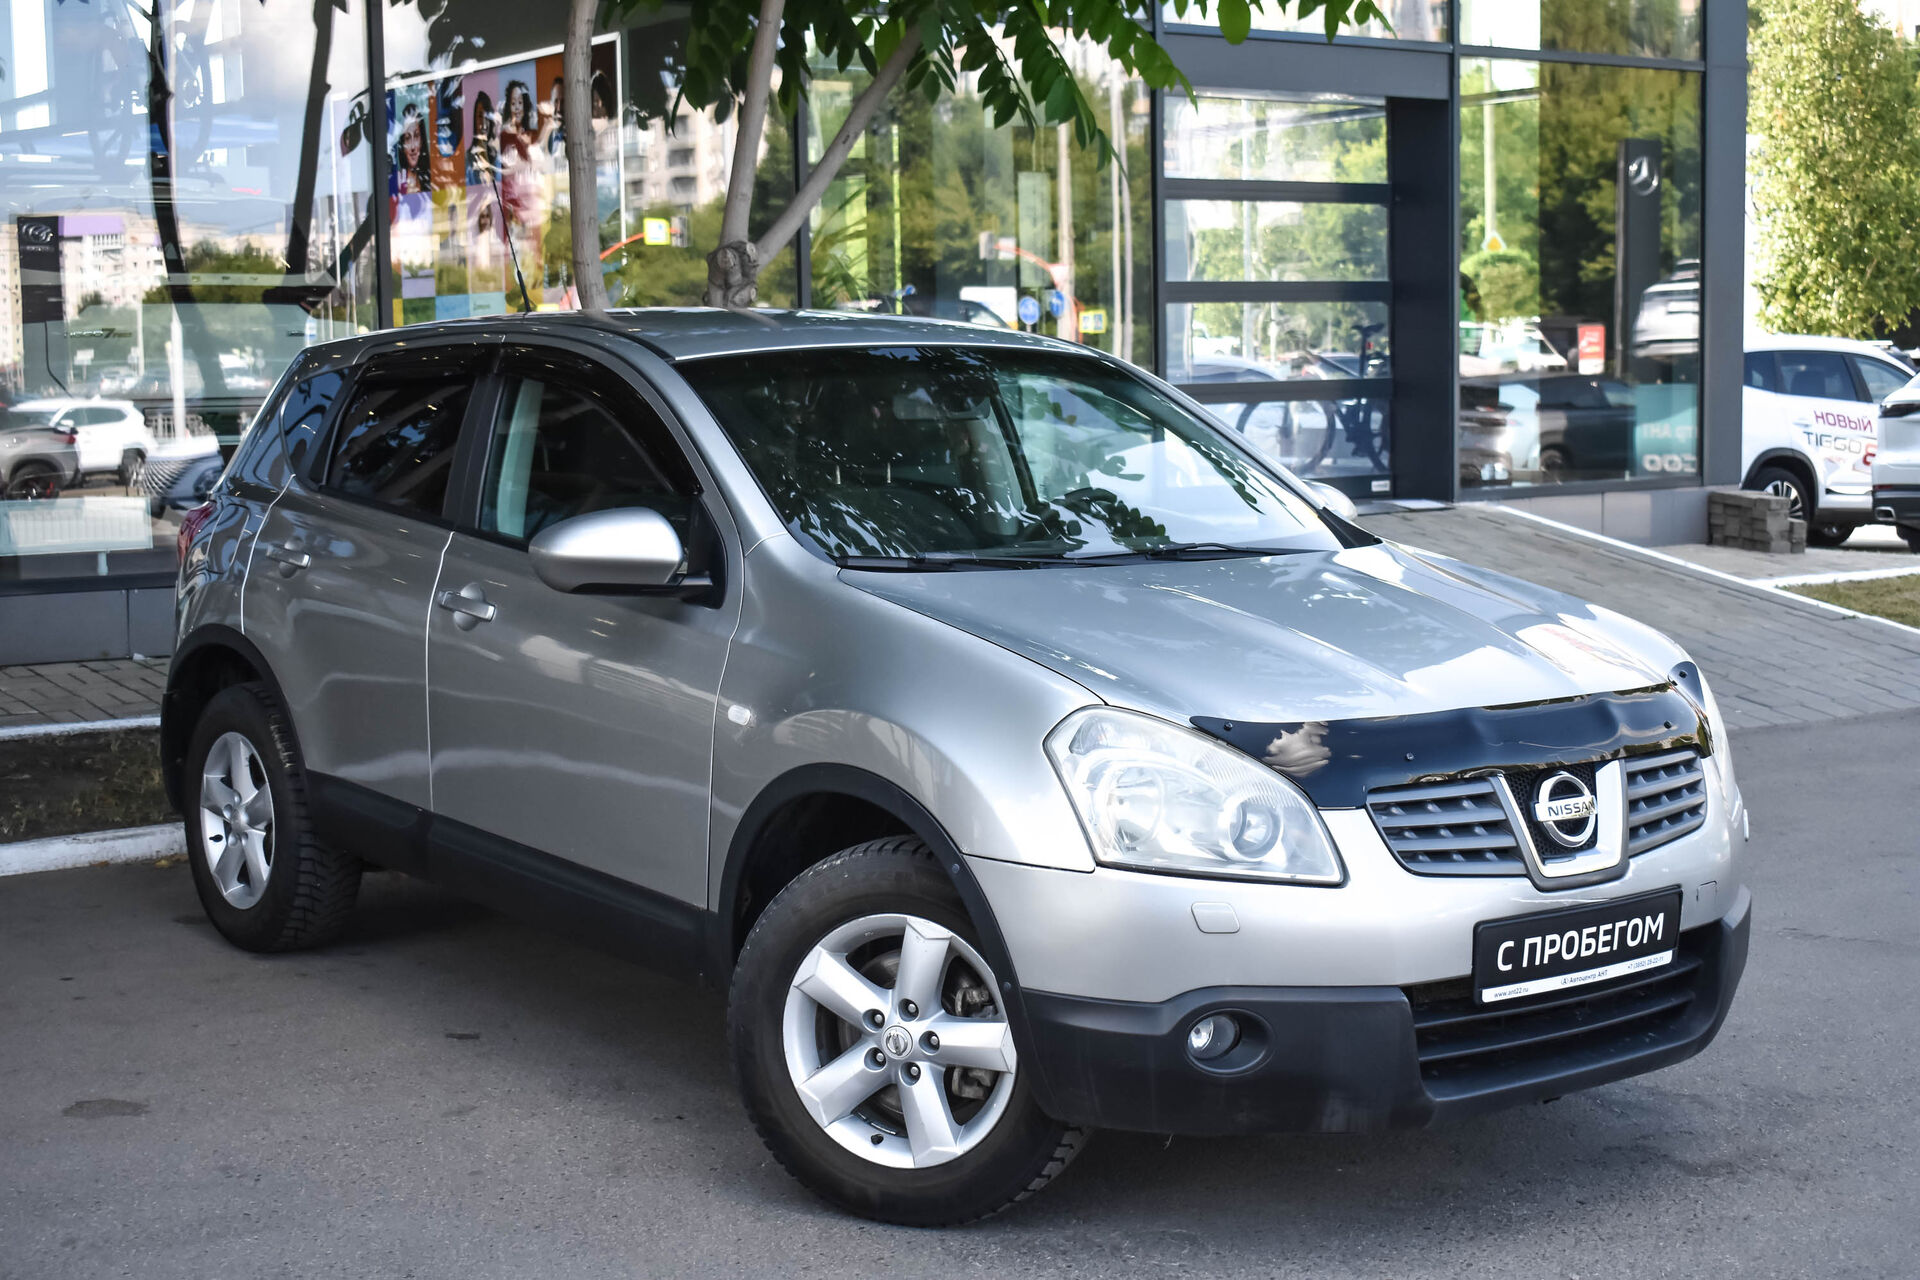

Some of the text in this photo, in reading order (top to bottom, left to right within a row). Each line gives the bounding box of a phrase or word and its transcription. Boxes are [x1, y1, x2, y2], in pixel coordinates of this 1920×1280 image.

[1814, 410, 1873, 433] НОВЫЙ
[1803, 431, 1862, 455] TIGGO
[1547, 796, 1596, 817] NISSAN
[1497, 912, 1665, 972] С ПРОБЕГОМ
